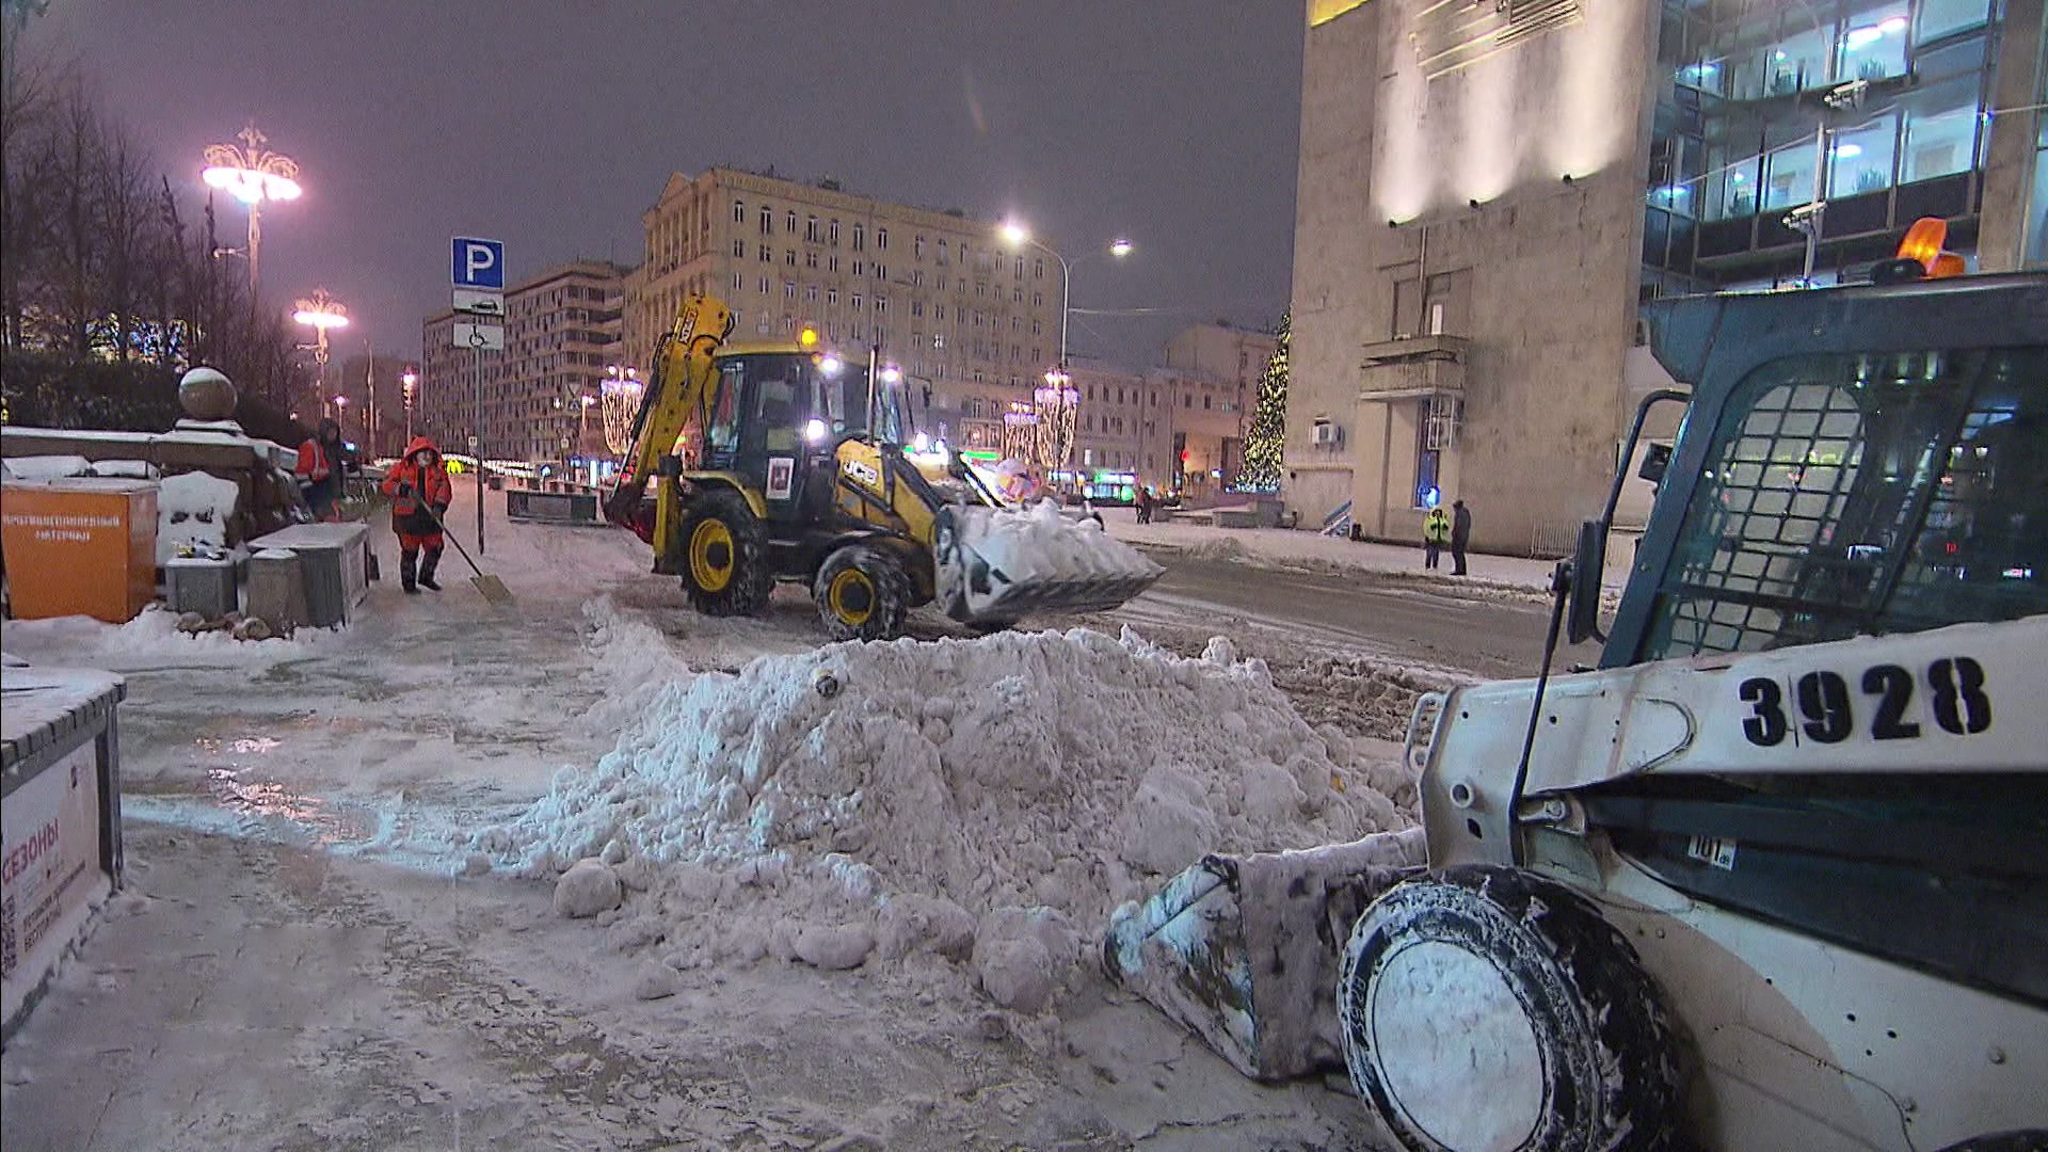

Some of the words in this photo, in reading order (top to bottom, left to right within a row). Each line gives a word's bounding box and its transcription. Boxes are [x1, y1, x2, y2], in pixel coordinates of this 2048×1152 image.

[466, 243, 495, 282] P
[844, 460, 878, 484] JCB
[1739, 656, 1992, 747] 3928
[2, 818, 59, 886] СЕЗОНЫ
